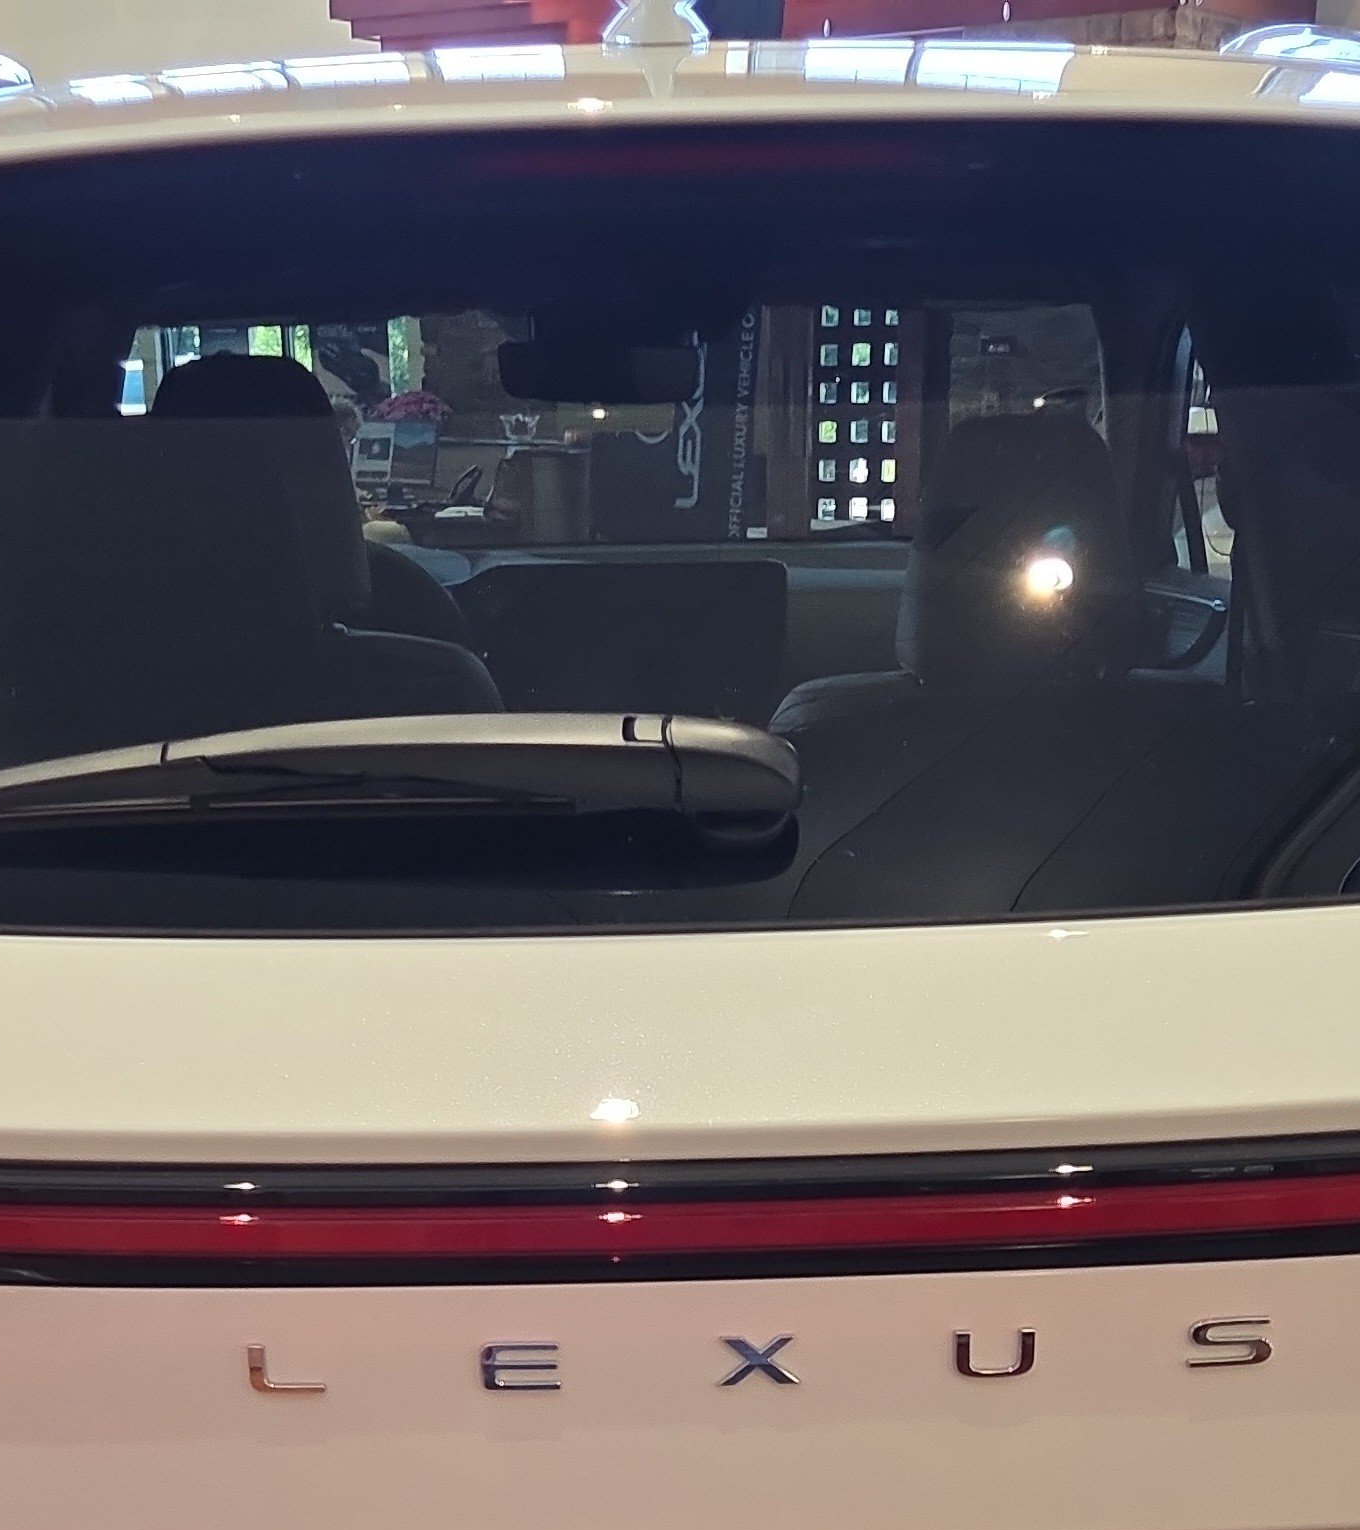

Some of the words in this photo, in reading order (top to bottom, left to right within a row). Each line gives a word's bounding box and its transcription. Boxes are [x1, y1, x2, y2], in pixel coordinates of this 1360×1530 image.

[737, 332, 755, 398] VEHICLE
[732, 403, 749, 468] LUXURY
[247, 1315, 1272, 1394] LEXUS
